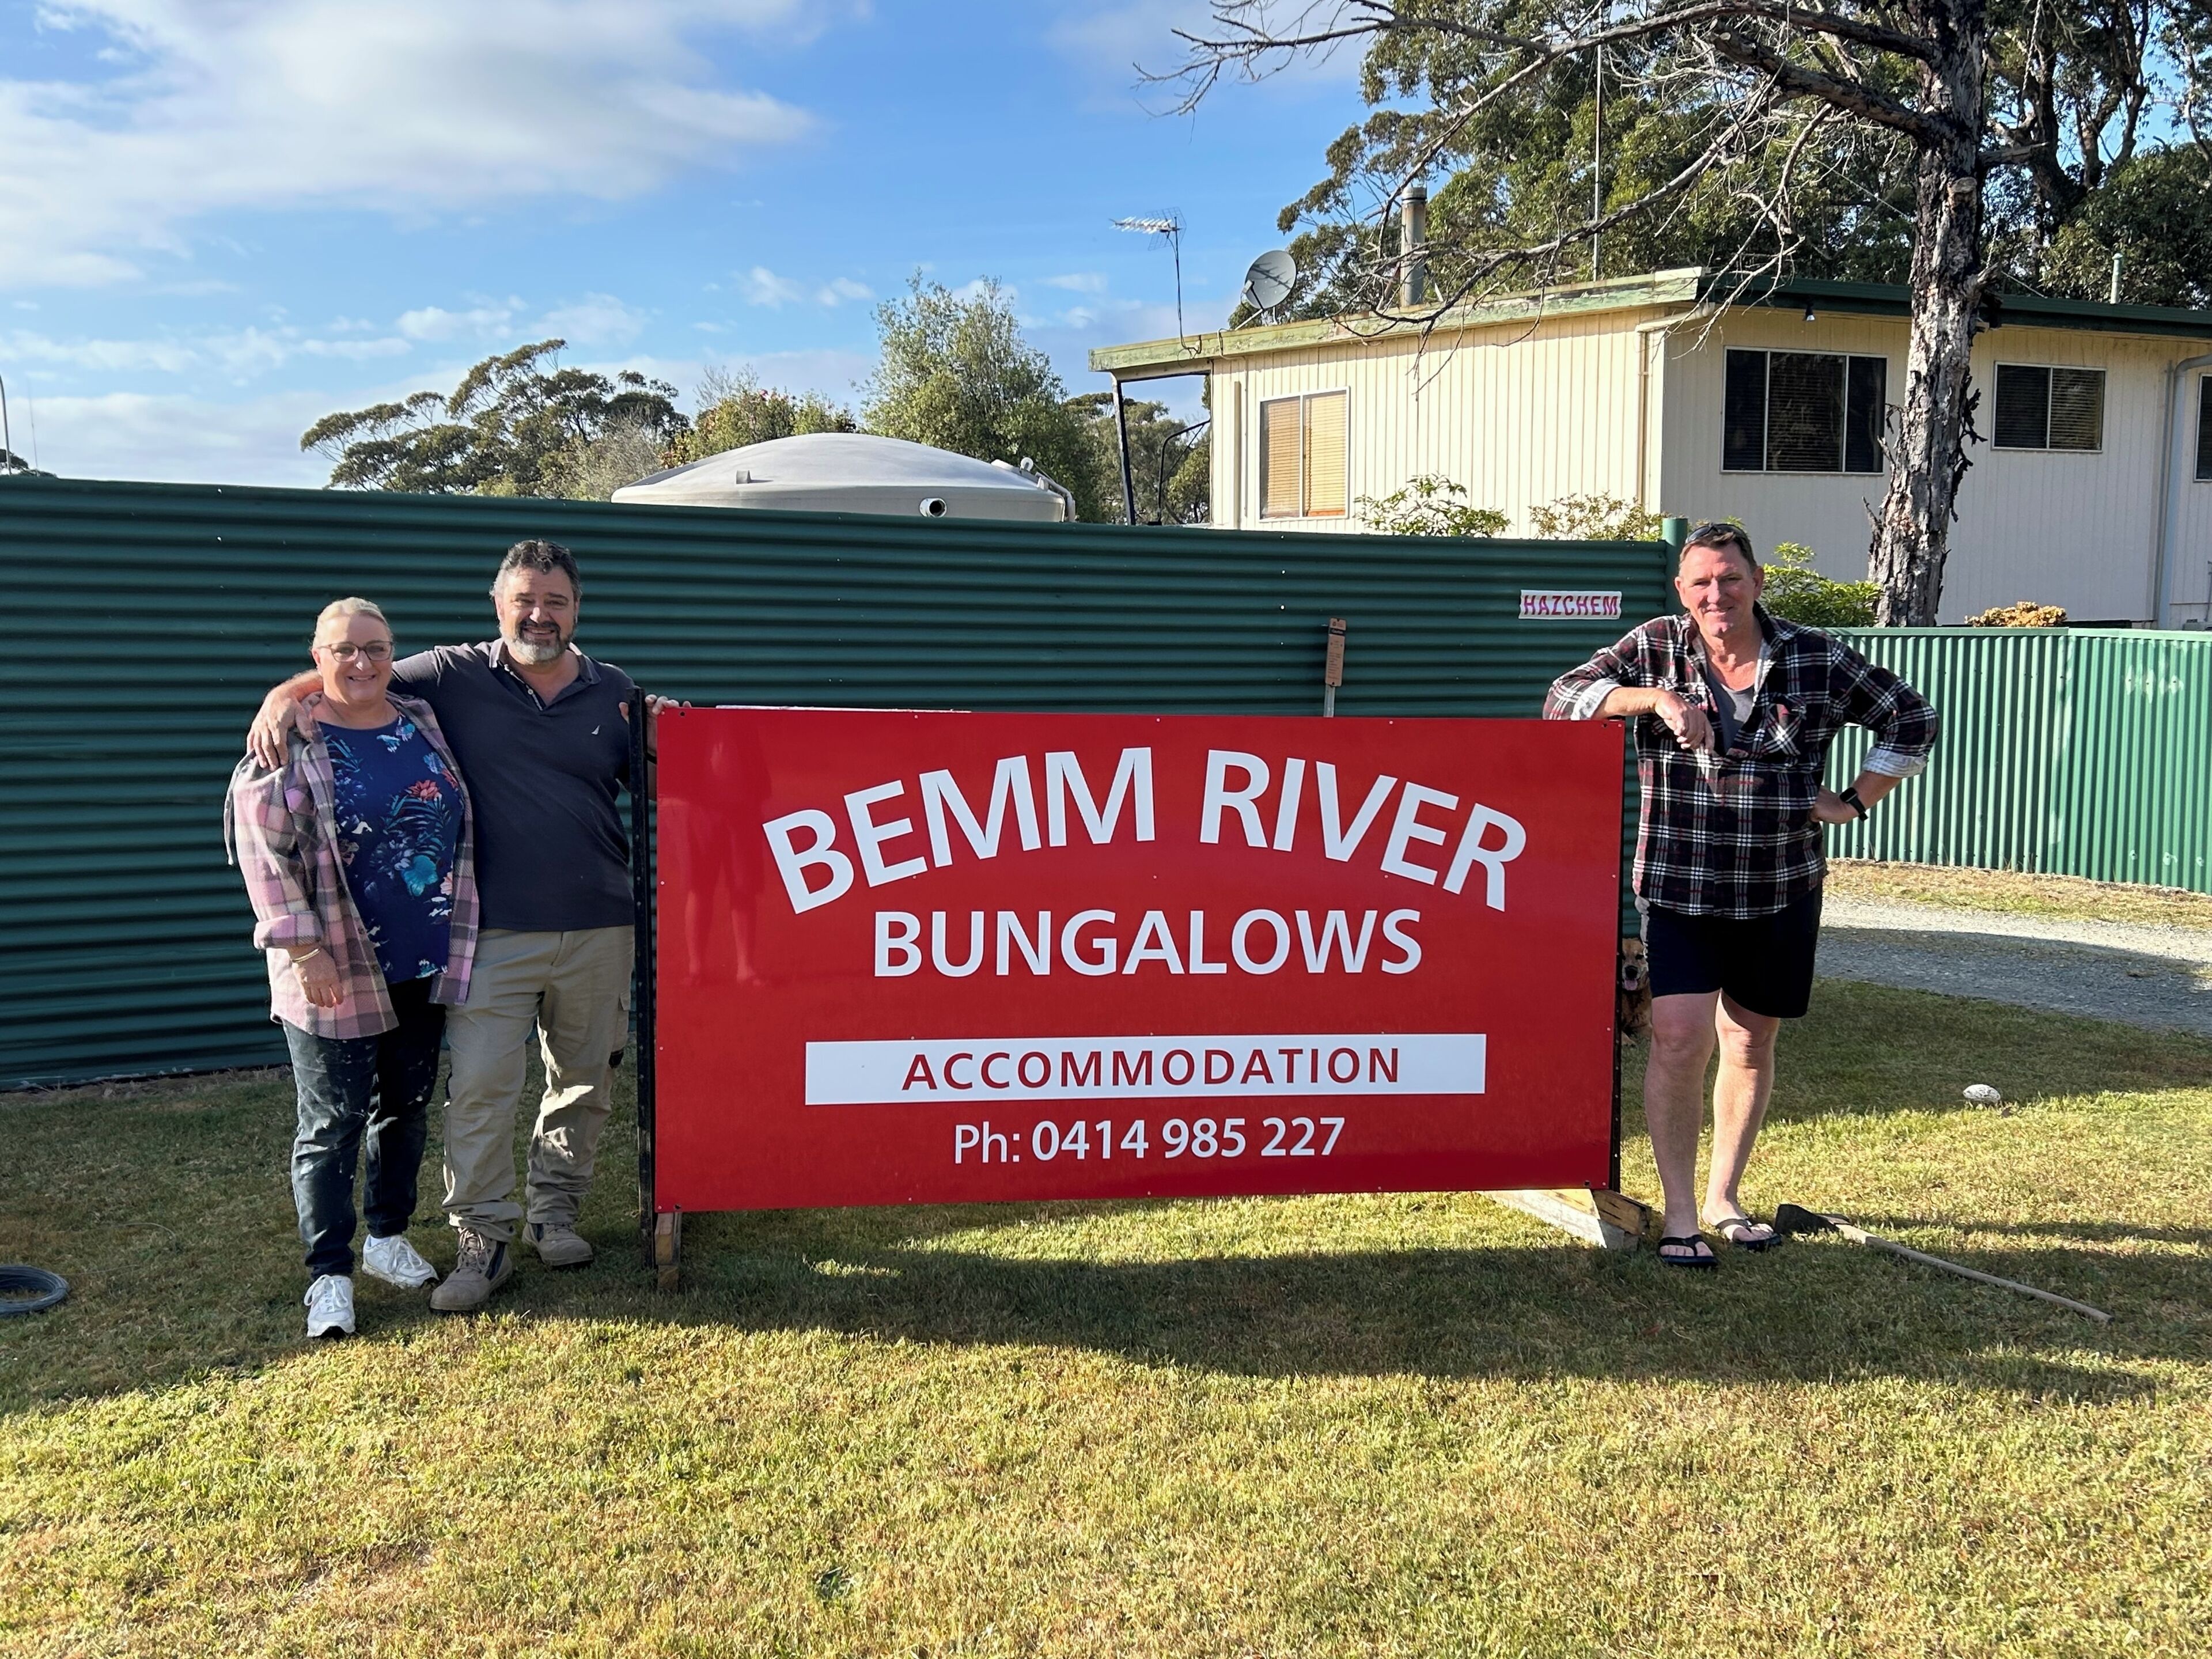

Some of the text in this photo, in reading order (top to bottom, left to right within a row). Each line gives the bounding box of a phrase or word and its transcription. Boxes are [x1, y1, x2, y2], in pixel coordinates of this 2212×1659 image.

[1524, 595, 1618, 616] HAZCHEM
[762, 747, 1527, 915] BEMM RIVER
[874, 909, 1422, 978] BUNGALOWS
[902, 1047, 1399, 1090] ACCOMMODATION
[955, 1117, 1345, 1164] Ph: 0414 985 227
